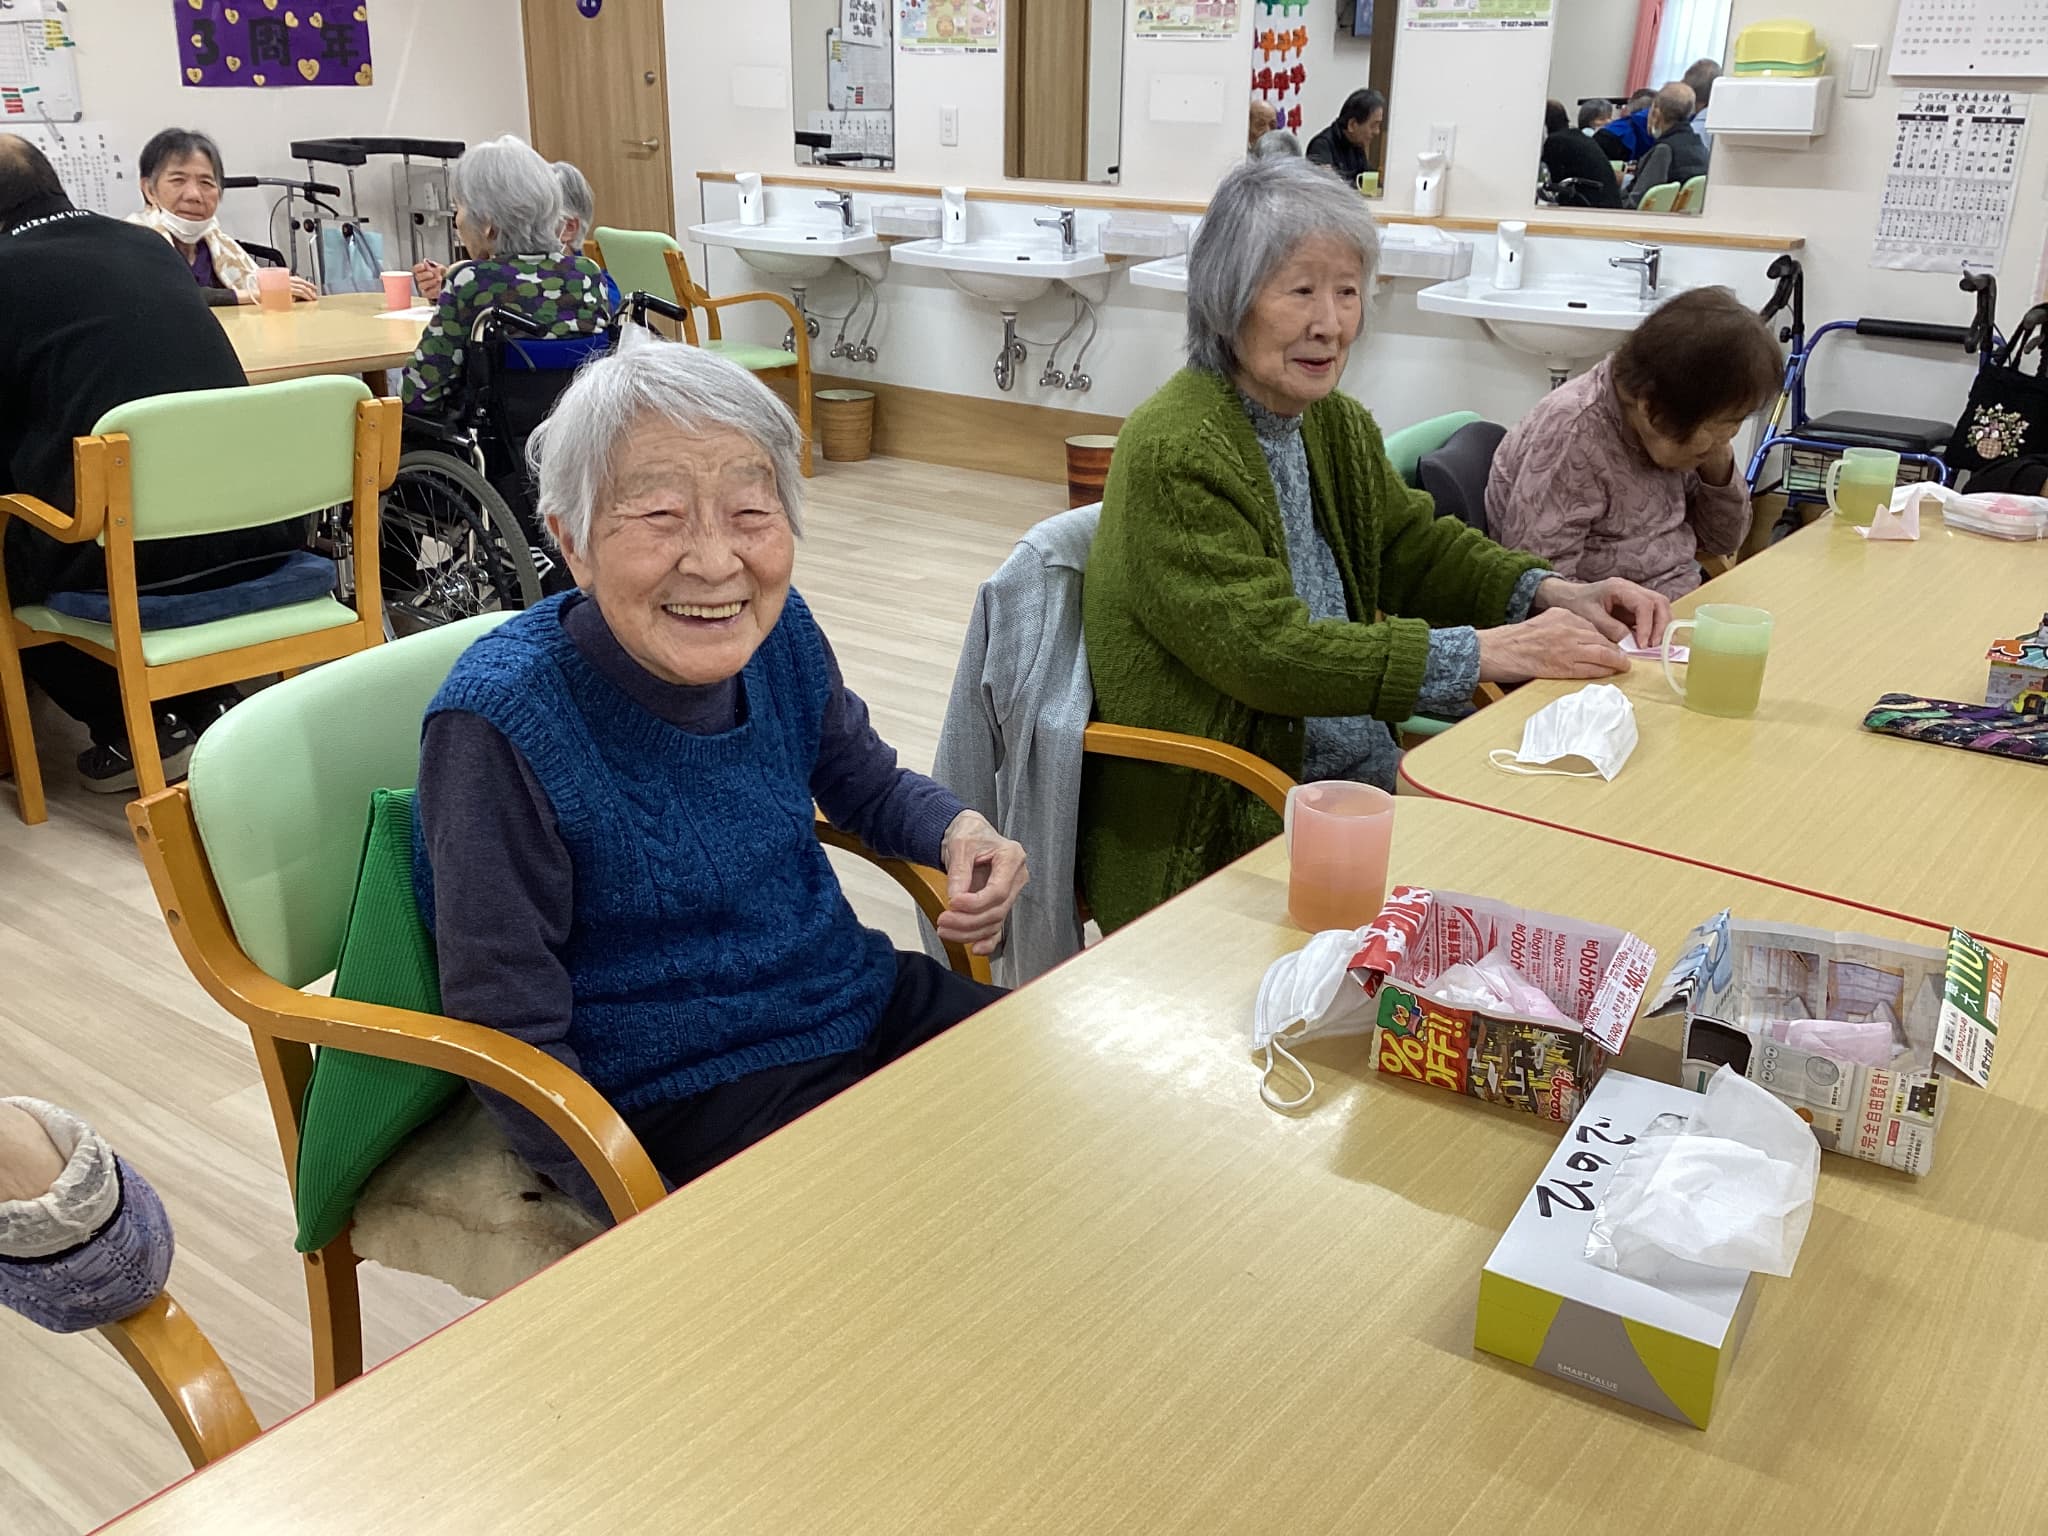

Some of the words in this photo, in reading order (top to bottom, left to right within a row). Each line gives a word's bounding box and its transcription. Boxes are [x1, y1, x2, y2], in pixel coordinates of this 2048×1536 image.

[191, 16, 360, 67] 3周年
[1579, 940, 1599, 999] 34,990円
[1536, 1116, 1636, 1217] ひので
